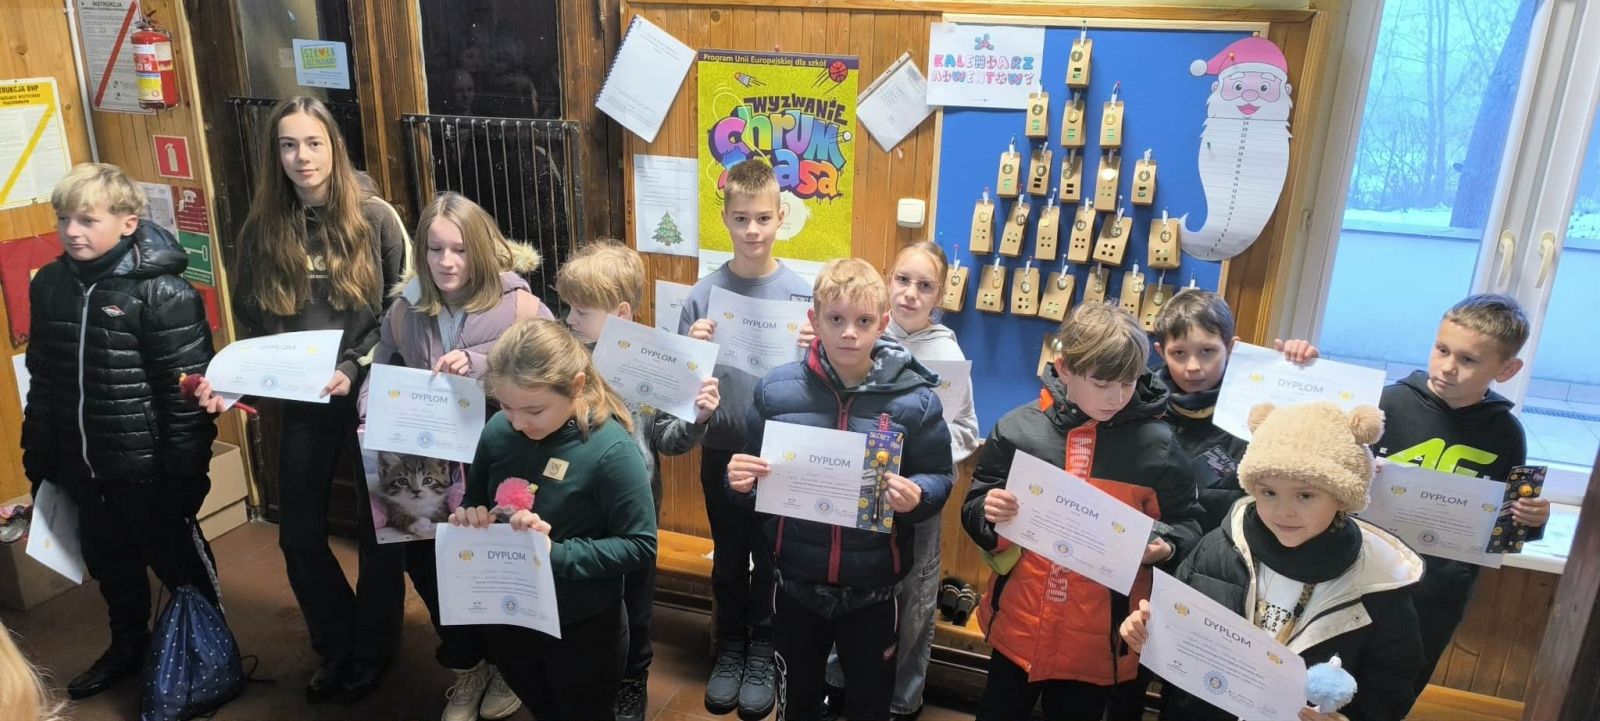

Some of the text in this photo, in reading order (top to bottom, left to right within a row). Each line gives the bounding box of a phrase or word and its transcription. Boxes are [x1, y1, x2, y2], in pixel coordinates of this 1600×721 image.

[703, 53, 733, 63] Program
[751, 56, 793, 66] Europejskiej
[795, 58, 806, 66] dla
[808, 59, 827, 67] szkół
[933, 54, 1034, 70] KALENDARZ
[742, 317, 777, 329] DYPLOM
[640, 347, 677, 365] DYPLOM
[1277, 378, 1324, 394] DYPLOM
[411, 392, 448, 404] DYPLOM
[809, 454, 851, 468] DYPLOM
[1055, 494, 1100, 520] DYPLOM
[1420, 491, 1468, 507] DYPLOM
[487, 550, 527, 561] DYPLOM
[1204, 617, 1251, 648] DYPLOM
